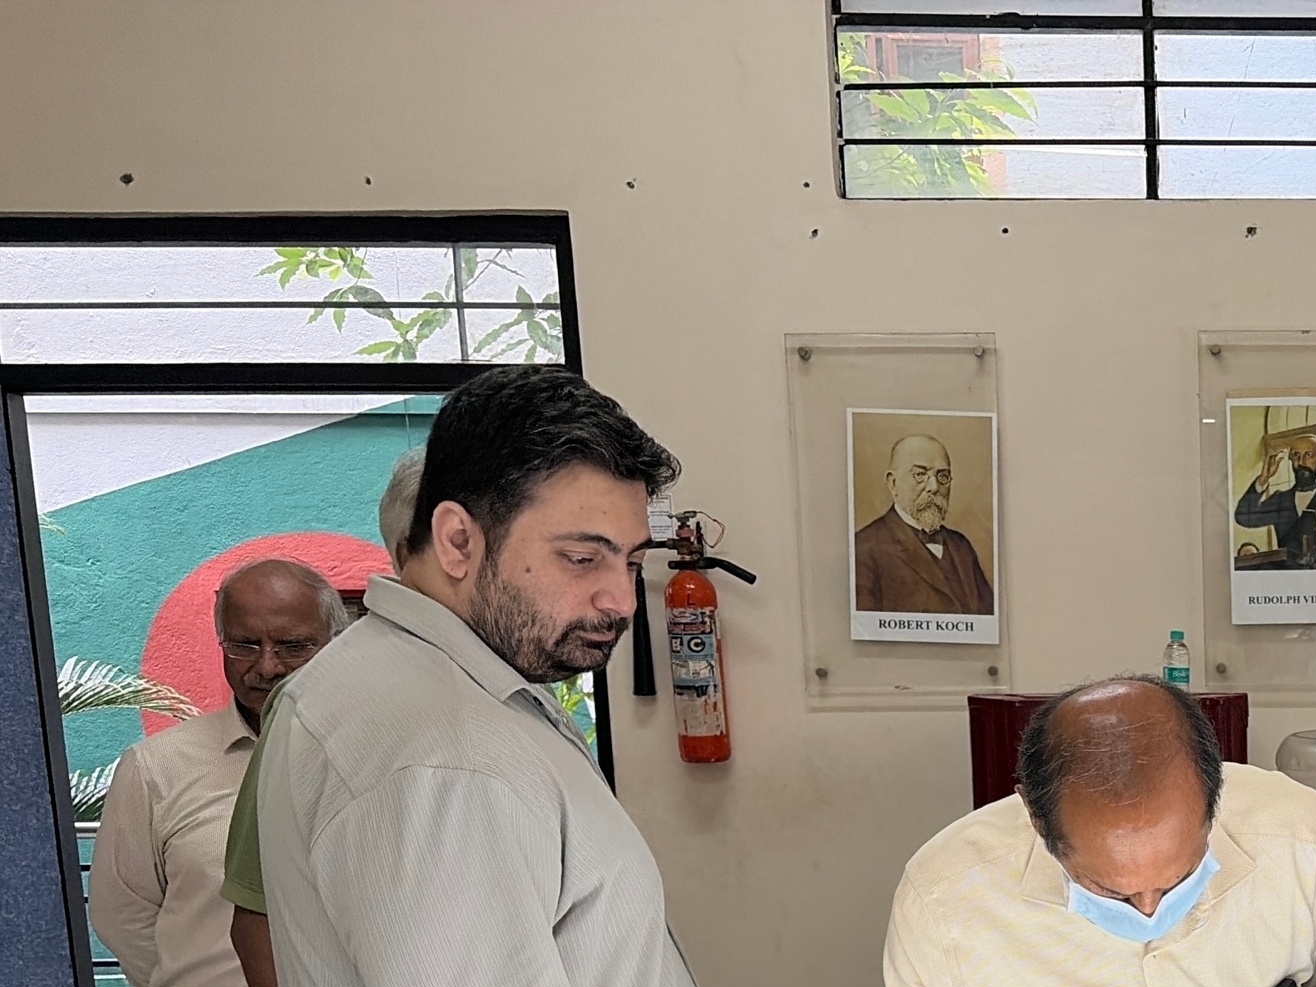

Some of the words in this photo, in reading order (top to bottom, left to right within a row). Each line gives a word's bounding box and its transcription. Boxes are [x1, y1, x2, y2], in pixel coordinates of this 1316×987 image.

[1248, 595, 1301, 605] RUDOLPH
[879, 619, 932, 630] ROBERT
[935, 621, 974, 632] KOCH
[689, 638, 704, 651] C
